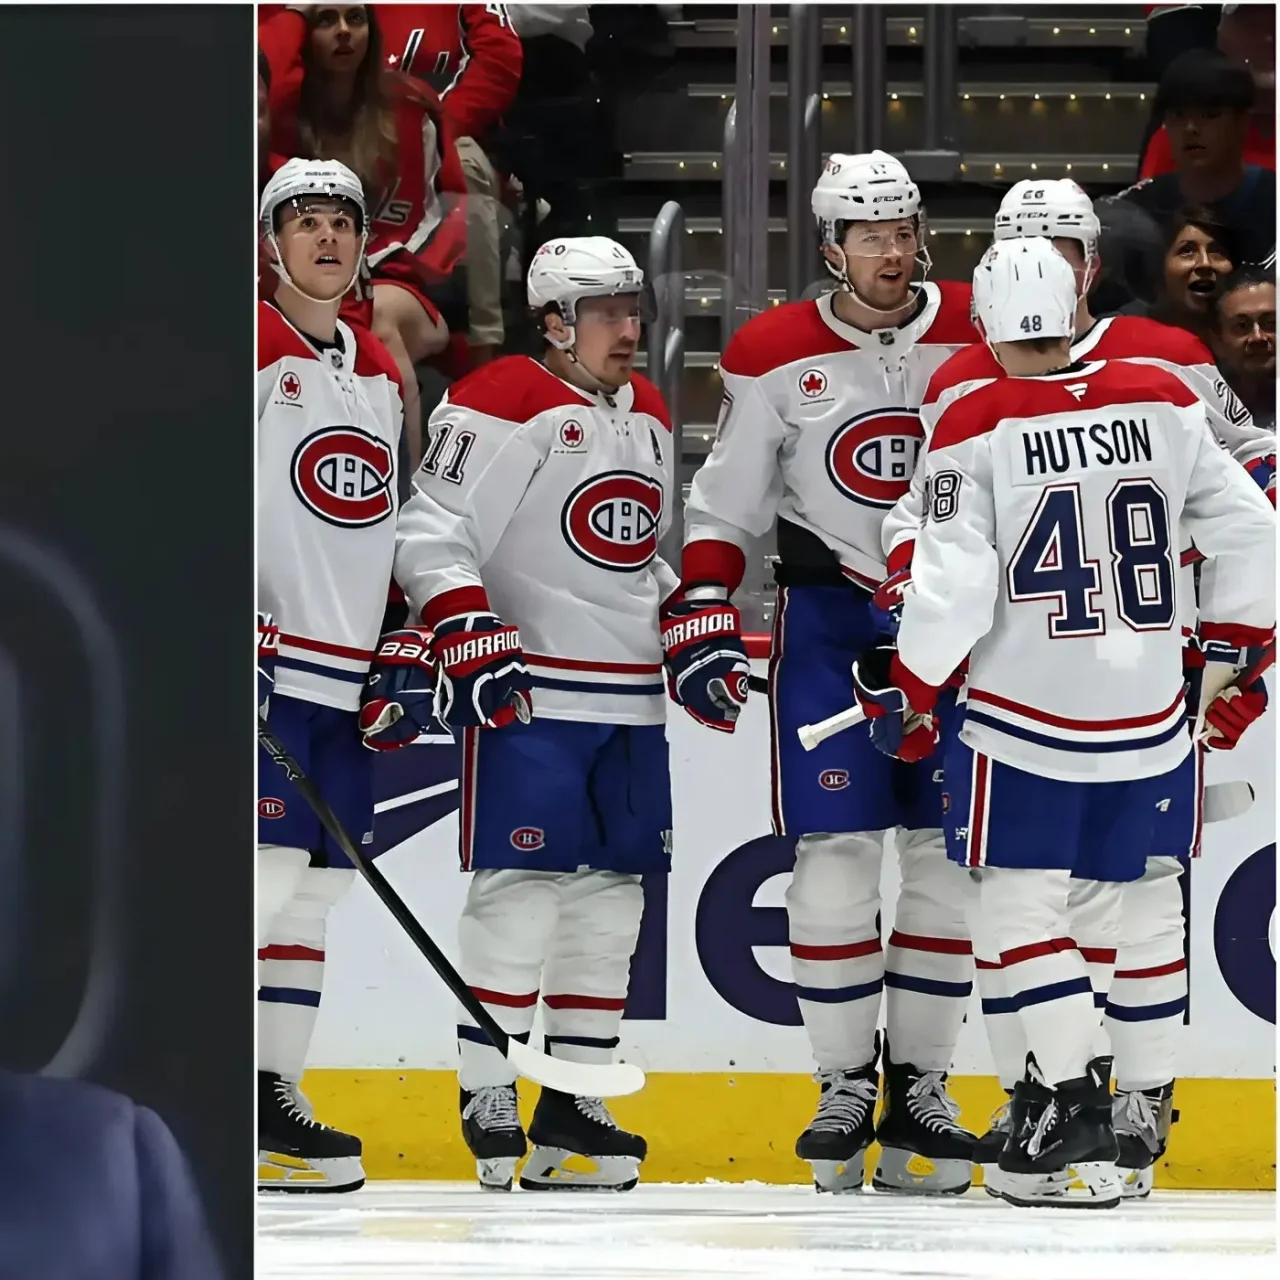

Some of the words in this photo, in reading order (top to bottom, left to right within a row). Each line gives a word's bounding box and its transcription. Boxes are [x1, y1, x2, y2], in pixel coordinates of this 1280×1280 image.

[1020, 314, 1043, 333] 48
[421, 422, 477, 486] 11
[1023, 418, 1153, 476] HUTSON
[922, 469, 963, 523] 8
[1007, 477, 1176, 639] 48
[442, 630, 523, 668] WARRIO
[662, 613, 735, 652] ARRIOR
